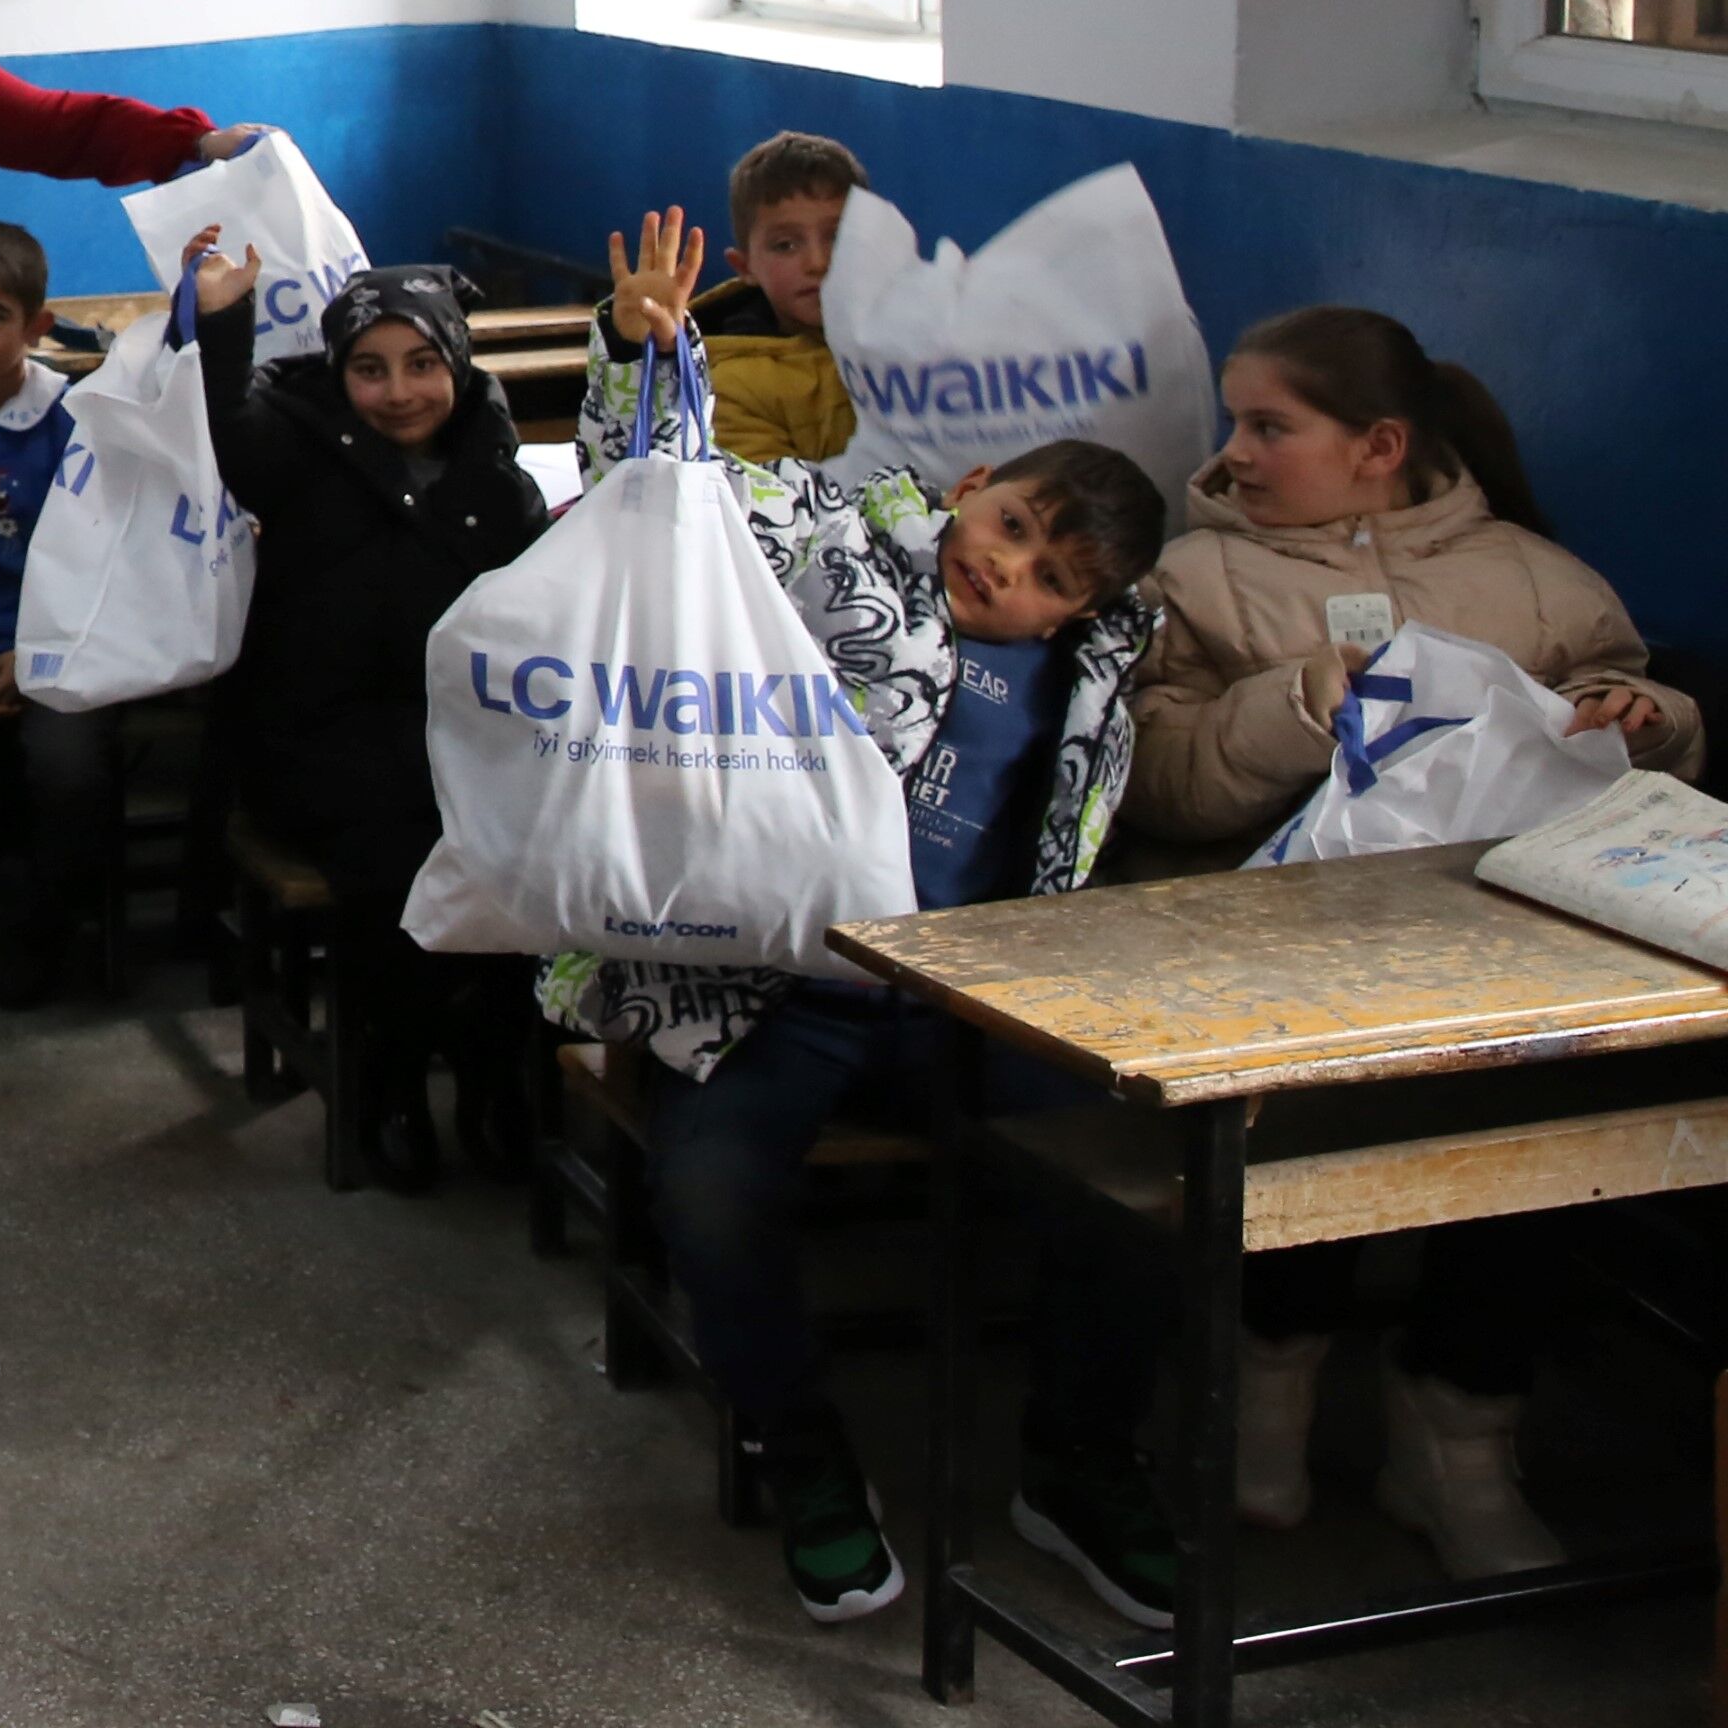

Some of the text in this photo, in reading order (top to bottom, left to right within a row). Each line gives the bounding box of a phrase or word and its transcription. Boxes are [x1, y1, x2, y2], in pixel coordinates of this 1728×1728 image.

[470, 650, 574, 721] LC
[533, 729, 559, 756] iyi
[567, 737, 660, 767] giyinmek
[666, 743, 761, 772] herkesin
